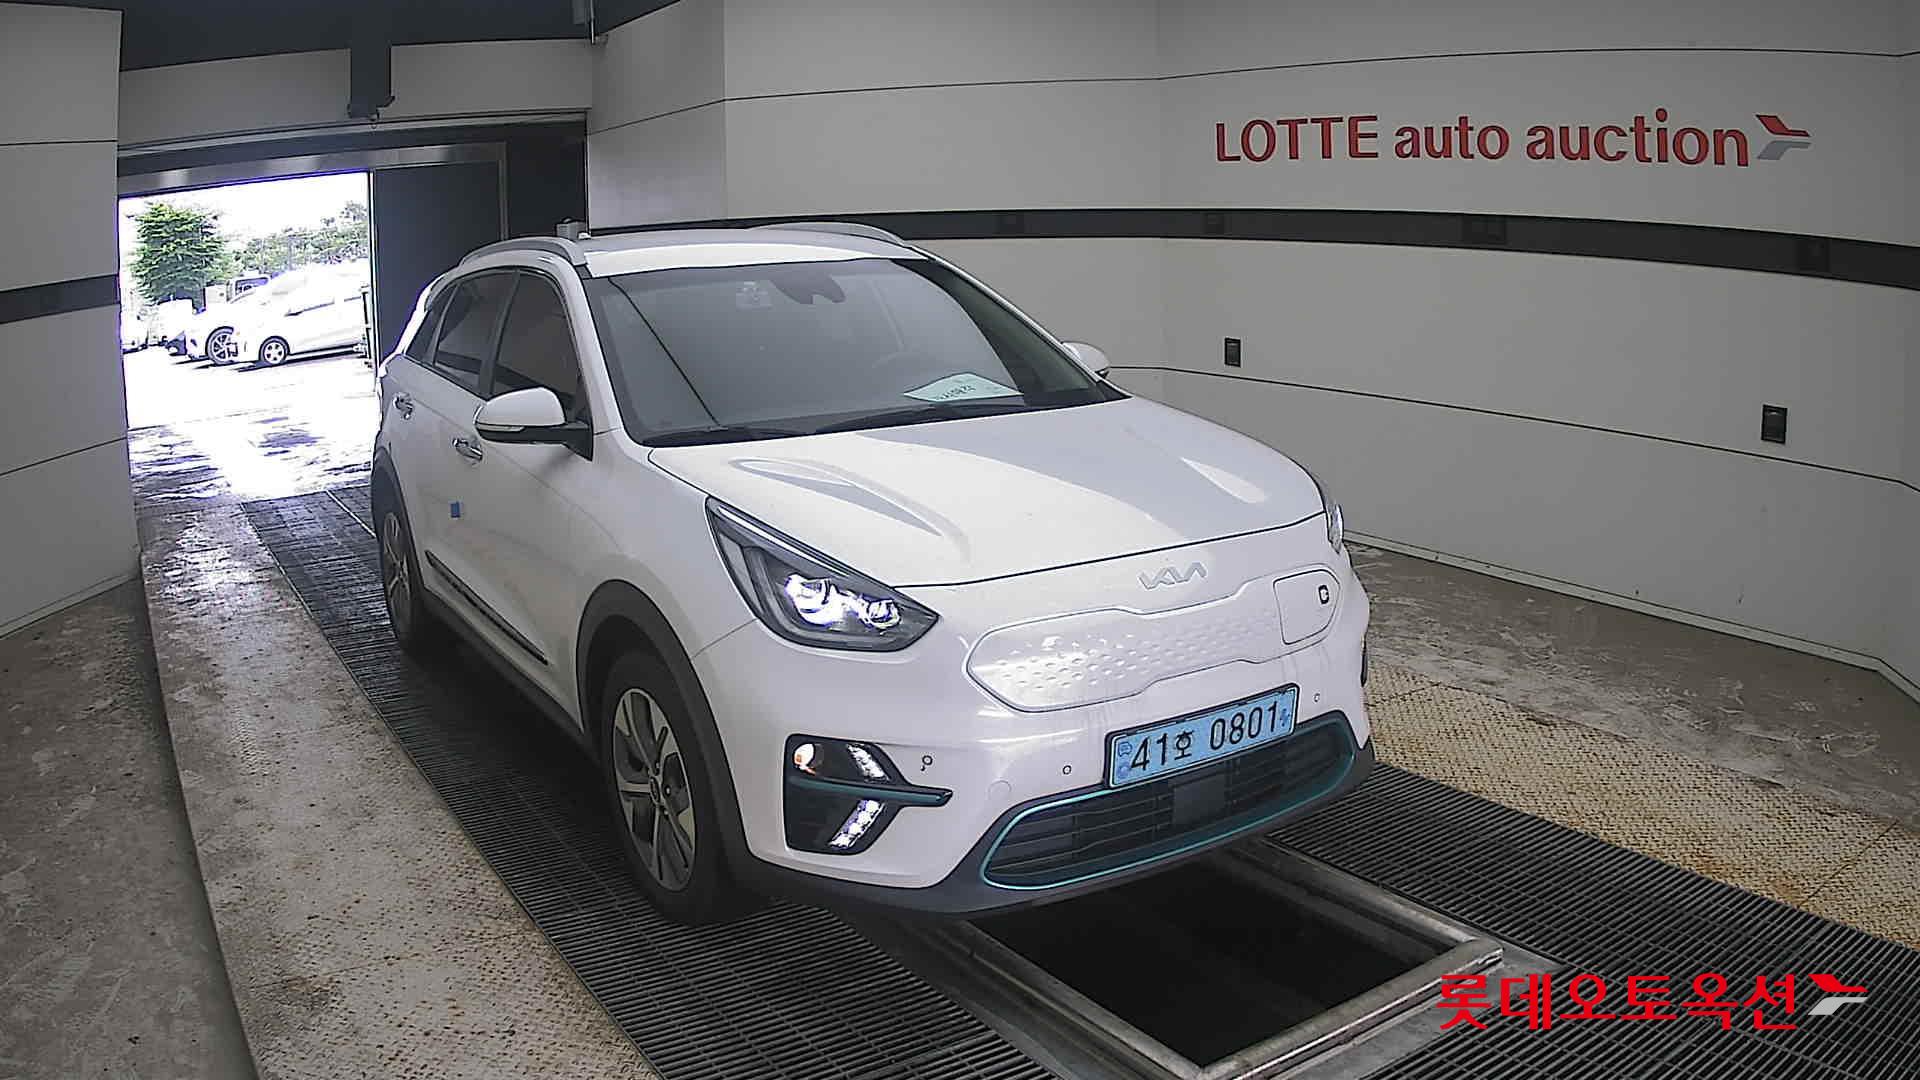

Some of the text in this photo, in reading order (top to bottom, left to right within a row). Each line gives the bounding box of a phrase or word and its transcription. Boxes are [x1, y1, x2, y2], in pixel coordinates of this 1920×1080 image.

[1215, 107, 1750, 167] LOTTE auto auction
[1138, 562, 1208, 590] KIA
[1130, 700, 1278, 771] 41호 0801
